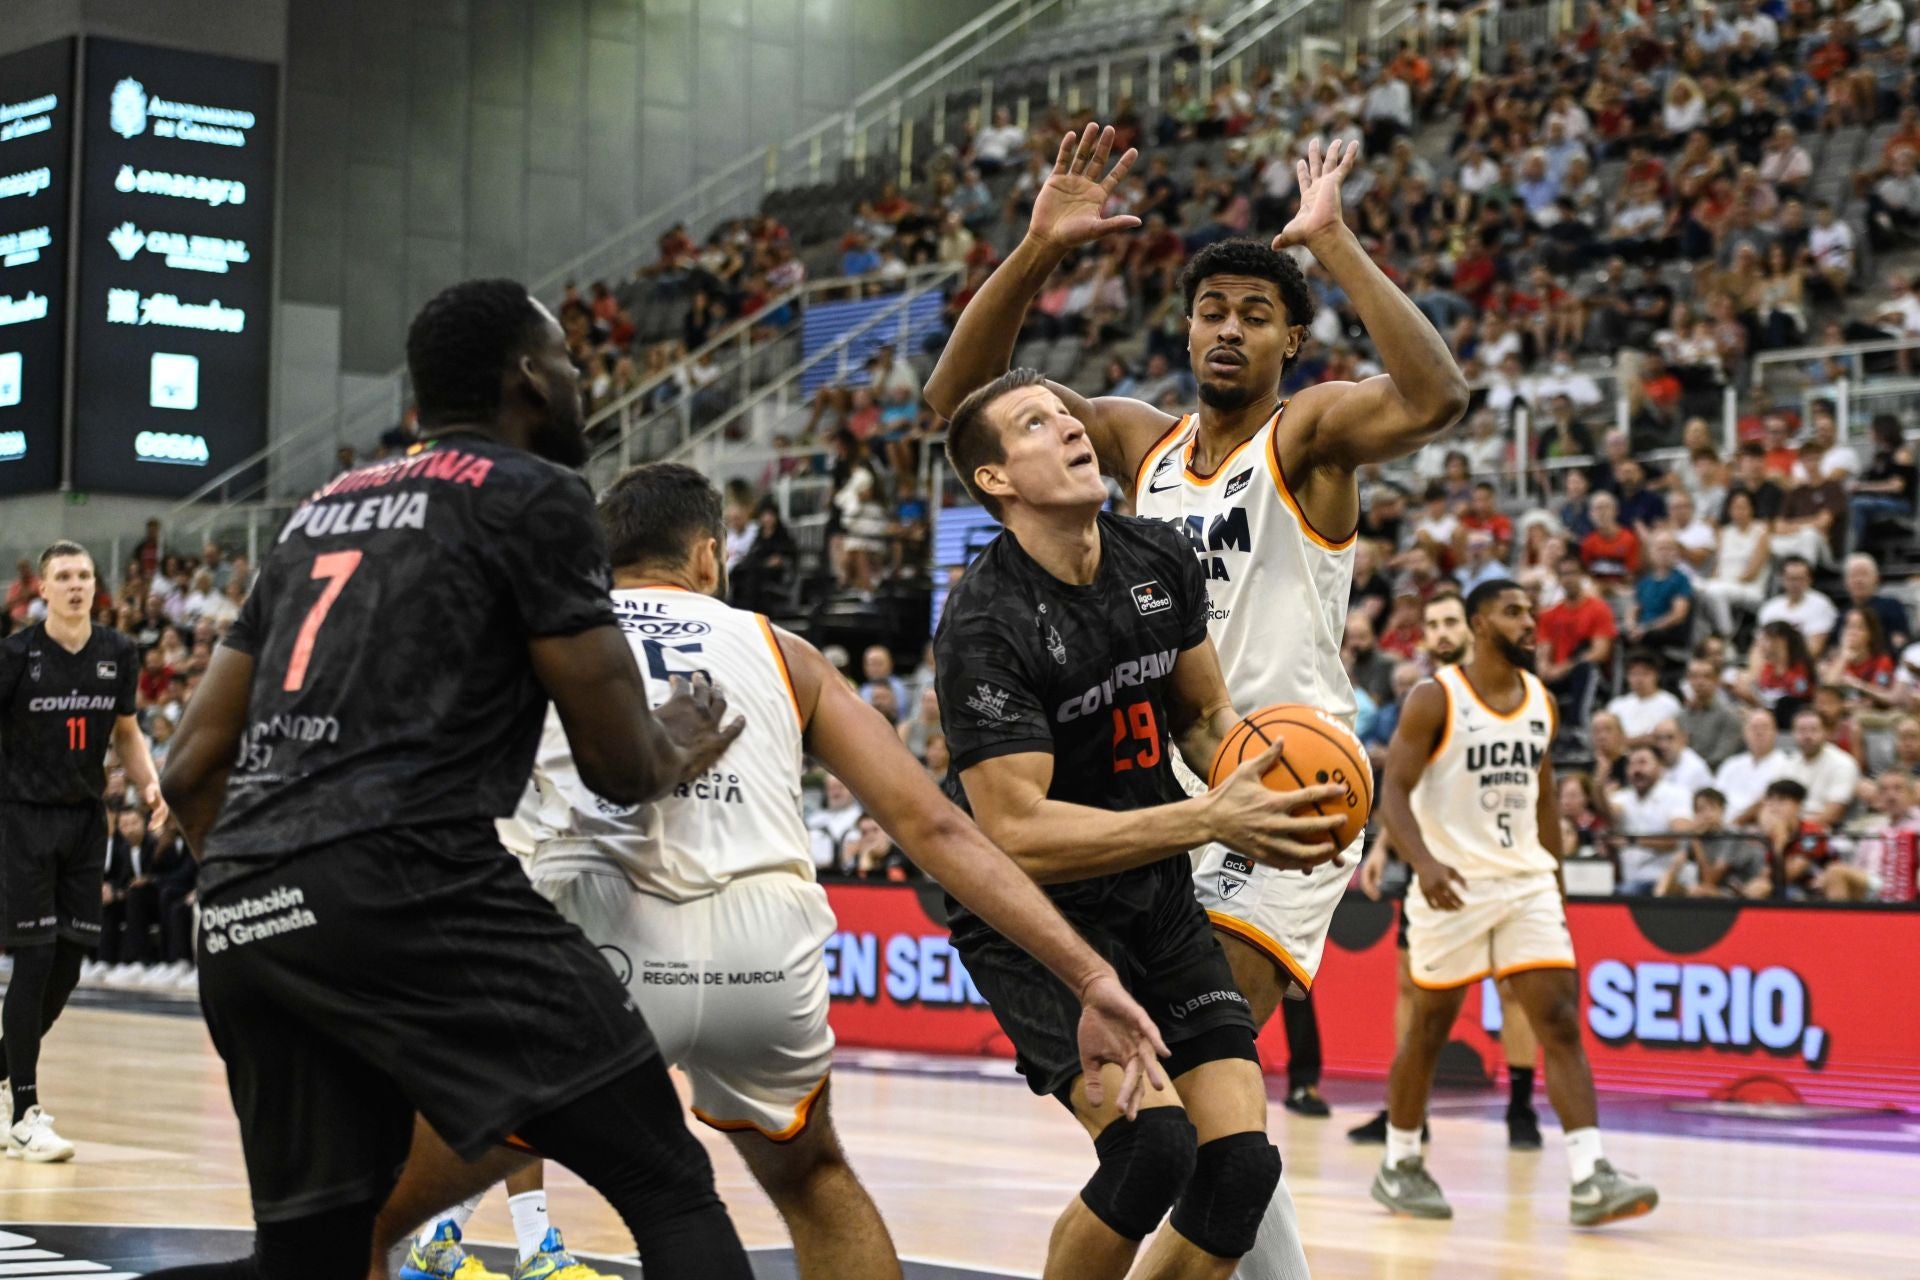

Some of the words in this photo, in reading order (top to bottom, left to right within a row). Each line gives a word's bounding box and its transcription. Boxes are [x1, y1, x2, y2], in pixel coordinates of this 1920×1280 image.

[278, 491, 429, 544] PULEVA
[283, 549, 363, 692] 7
[66, 716, 87, 751] 11
[1112, 700, 1161, 774] 29
[1497, 812, 1514, 848] 5
[1225, 860, 1247, 872] acb
[202, 885, 305, 932] Diputación
[206, 931, 229, 954] de
[228, 908, 318, 945] Granada
[643, 970, 700, 985] REGIÓN
[703, 972, 723, 985] DE
[728, 970, 786, 985] MURCIA
[1587, 959, 1826, 1063] SERIO,
